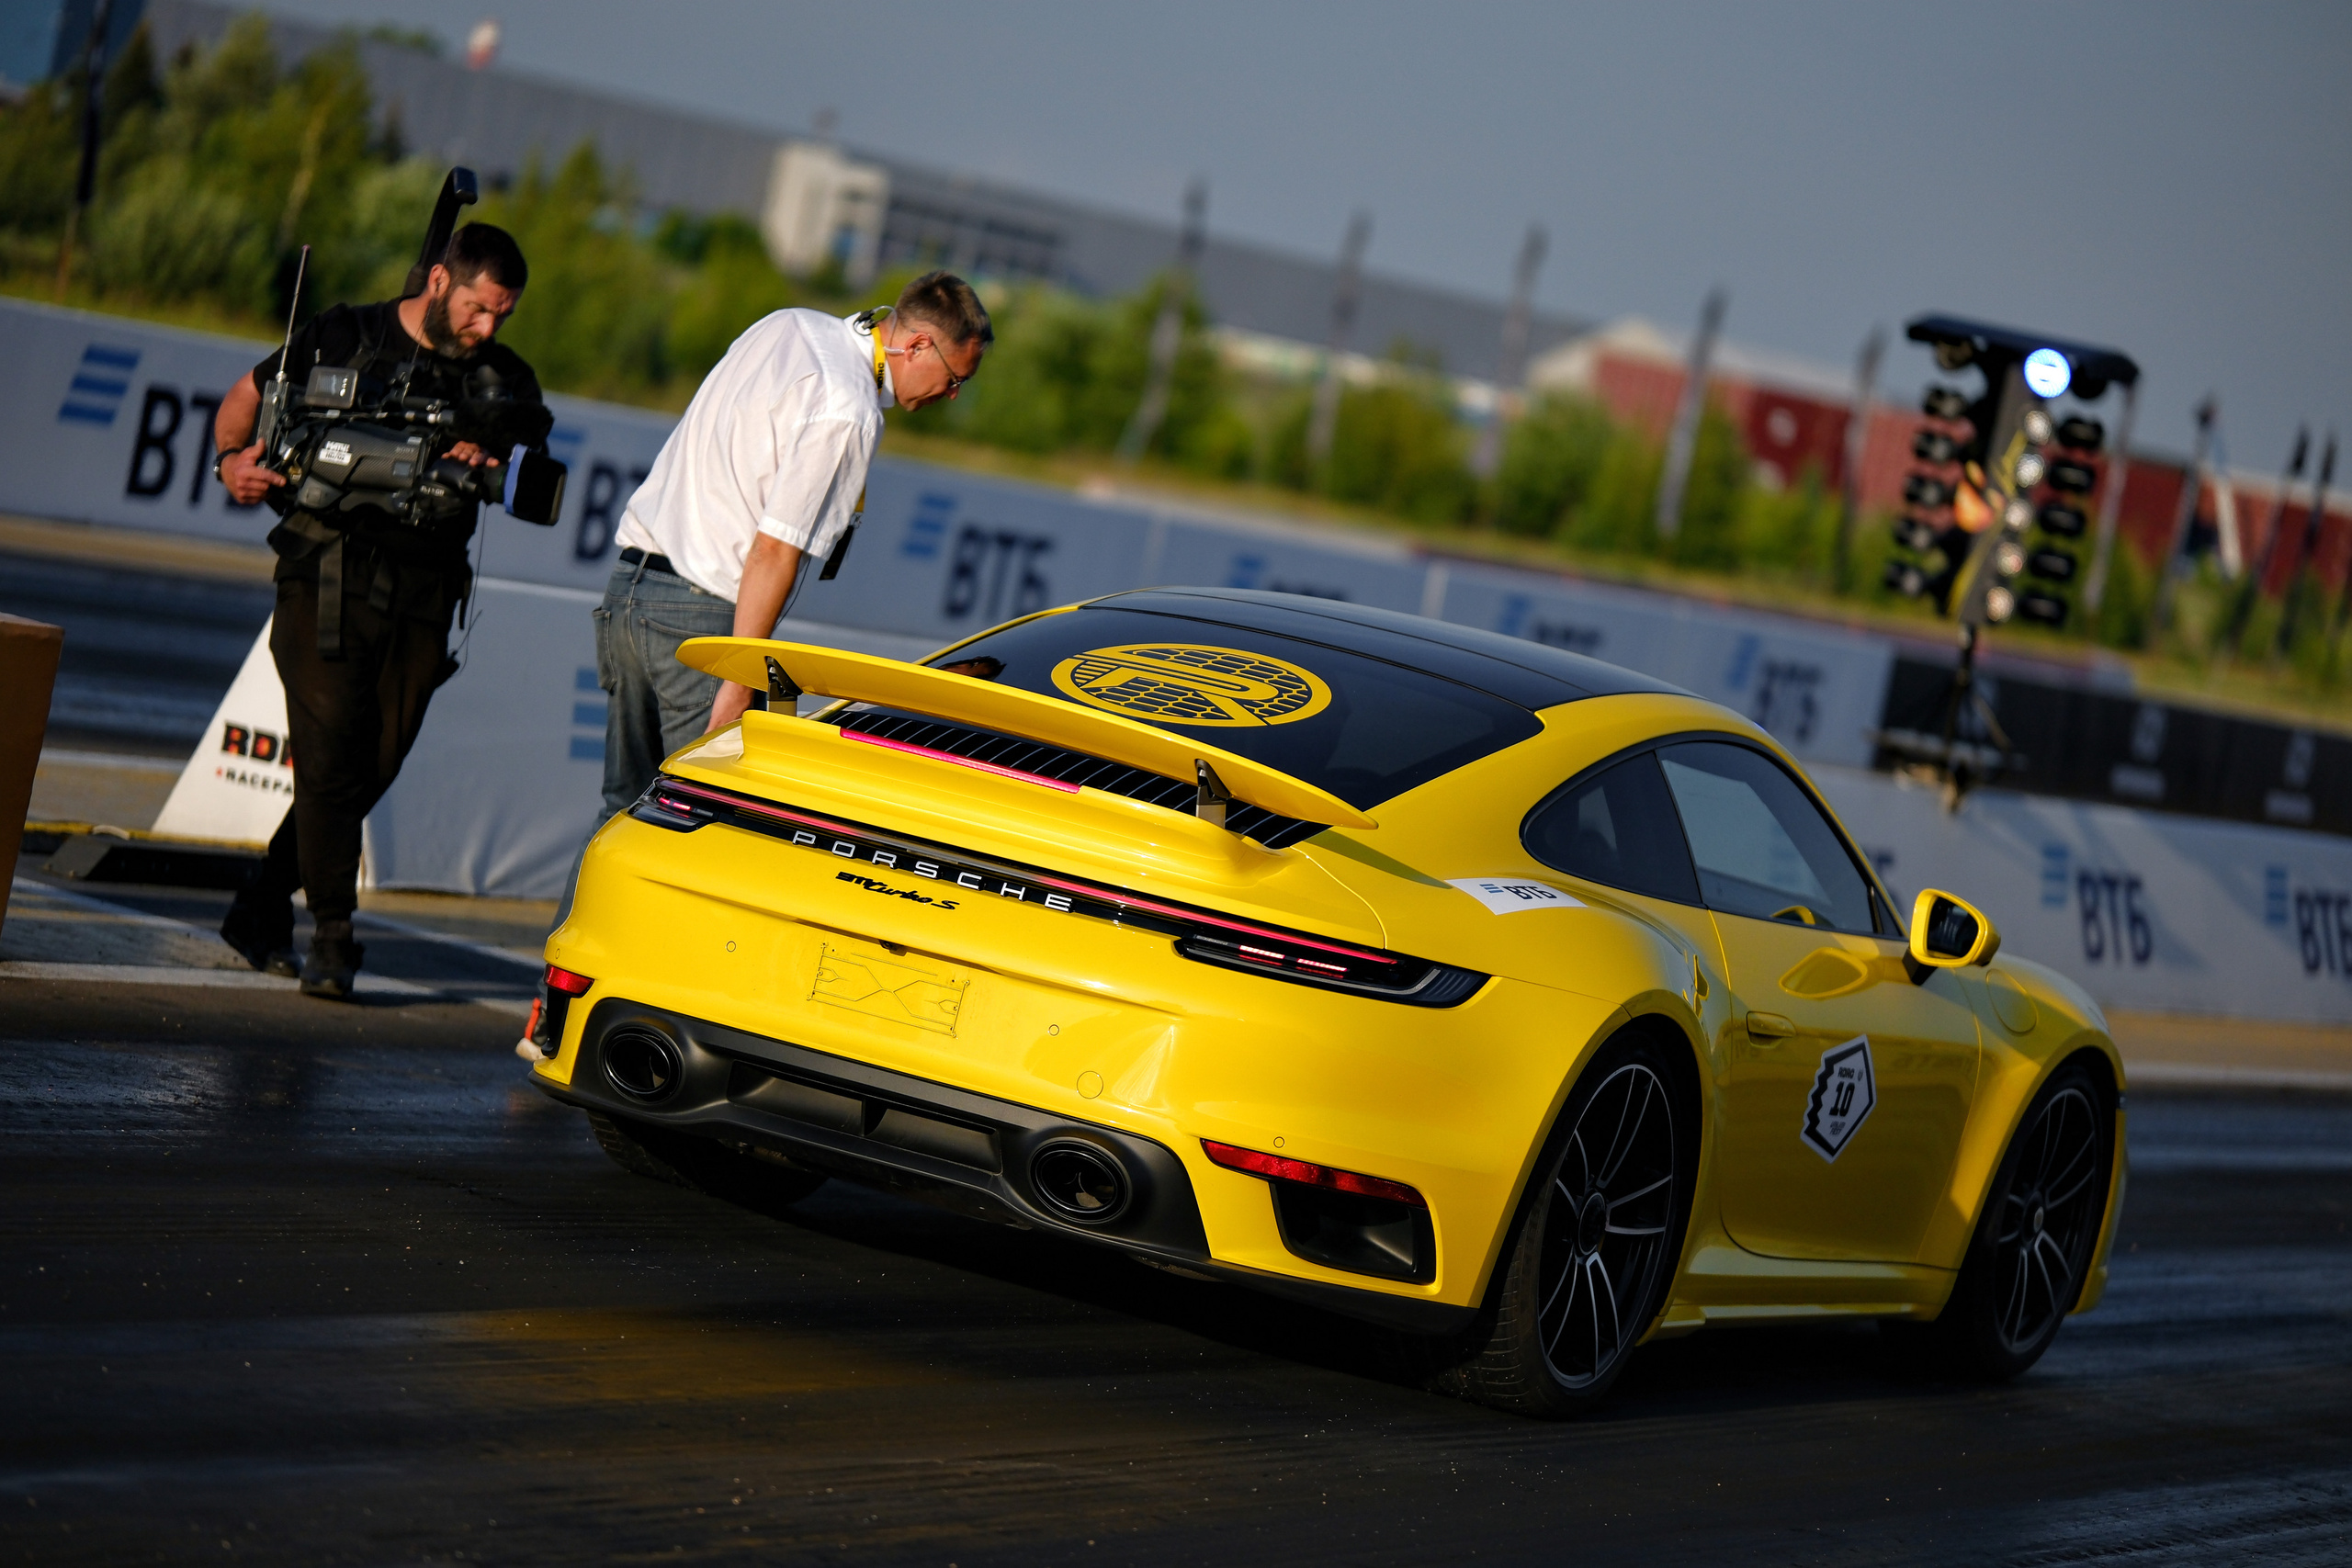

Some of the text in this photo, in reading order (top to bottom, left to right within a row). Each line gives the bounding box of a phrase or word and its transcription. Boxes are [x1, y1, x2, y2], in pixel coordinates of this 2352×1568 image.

[126, 386, 266, 511] ВТ
[792, 829, 1073, 912] PORSCHE
[1501, 886, 1557, 900] ВТБ
[2077, 868, 2153, 966] ВТБ
[1828, 1081, 1856, 1118] 10
